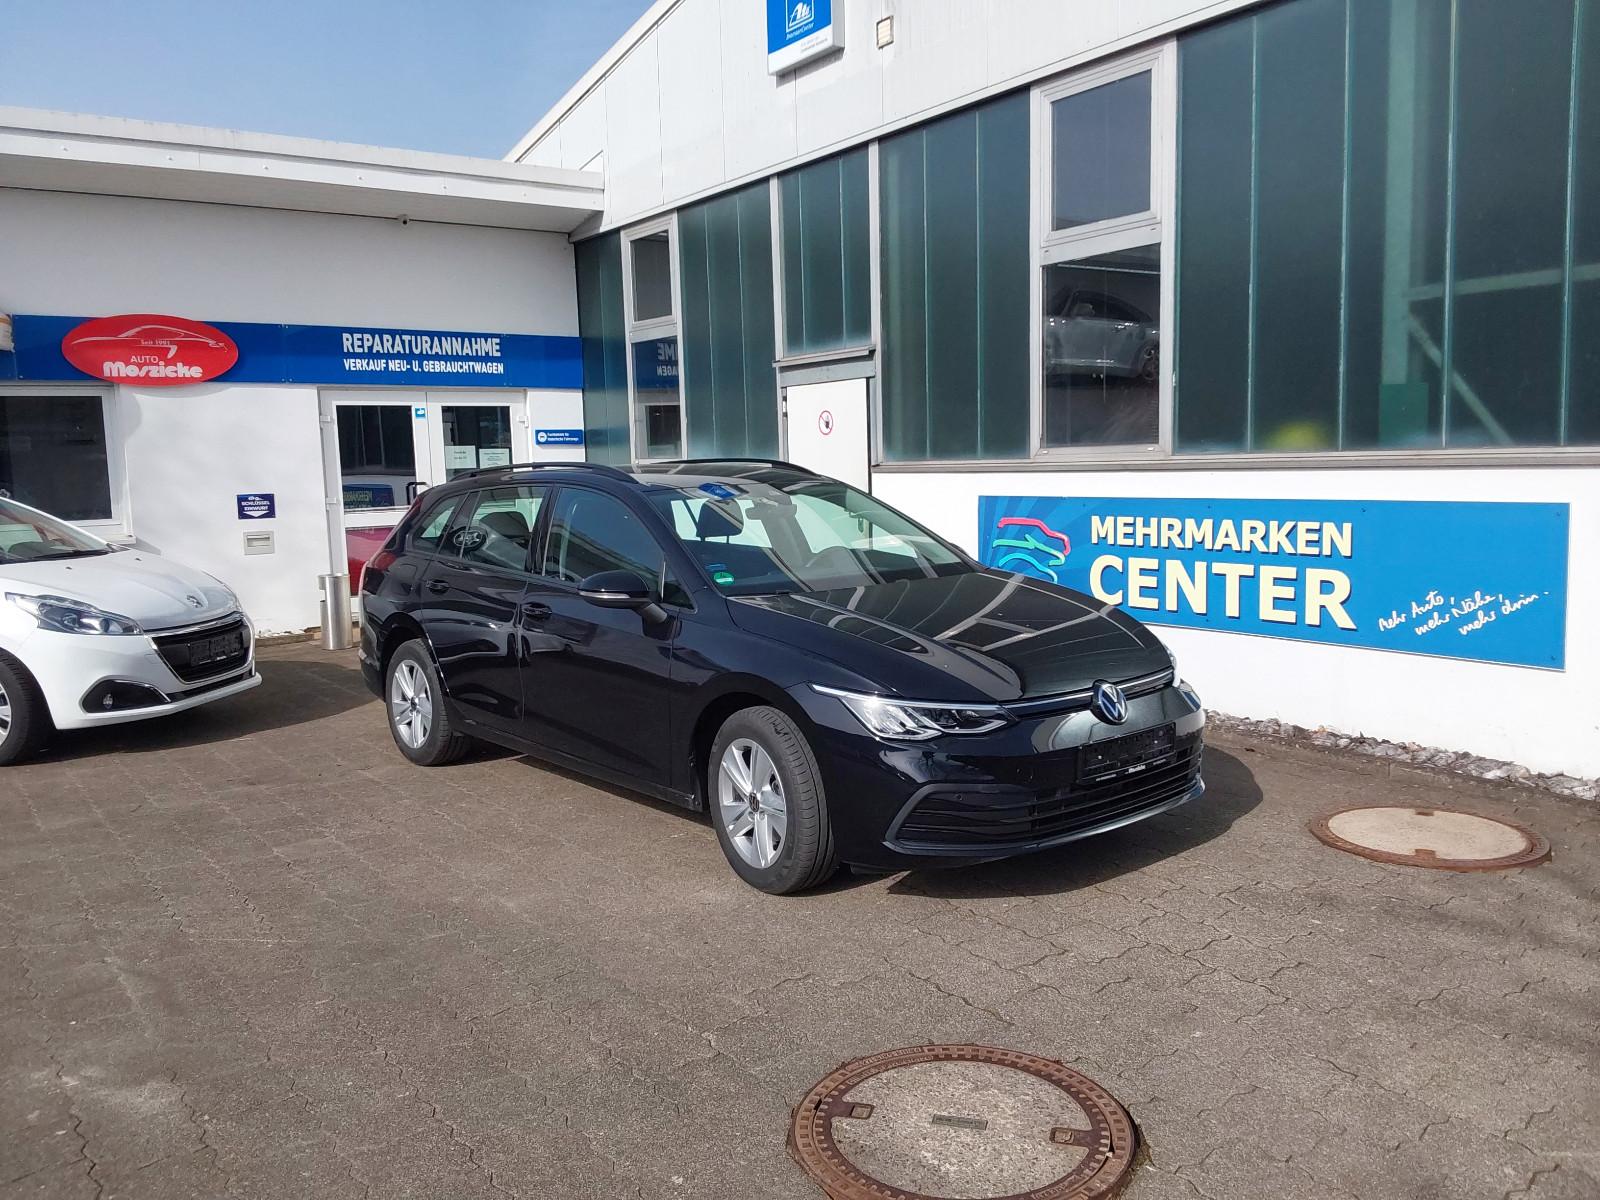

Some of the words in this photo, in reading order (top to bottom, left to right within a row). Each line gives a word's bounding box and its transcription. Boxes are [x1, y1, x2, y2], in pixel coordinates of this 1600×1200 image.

[342, 333, 501, 356] REPARATURANNAHME
[130, 355, 159, 363] AUTO
[344, 359, 387, 371] VERKAUF
[389, 360, 411, 371] NEU-
[412, 361, 422, 372] U.
[423, 361, 504, 374] GEBRAUCHTWAGEN
[1091, 515, 1352, 557] MEHRMARKEN
[1090, 554, 1357, 630] CENTER
